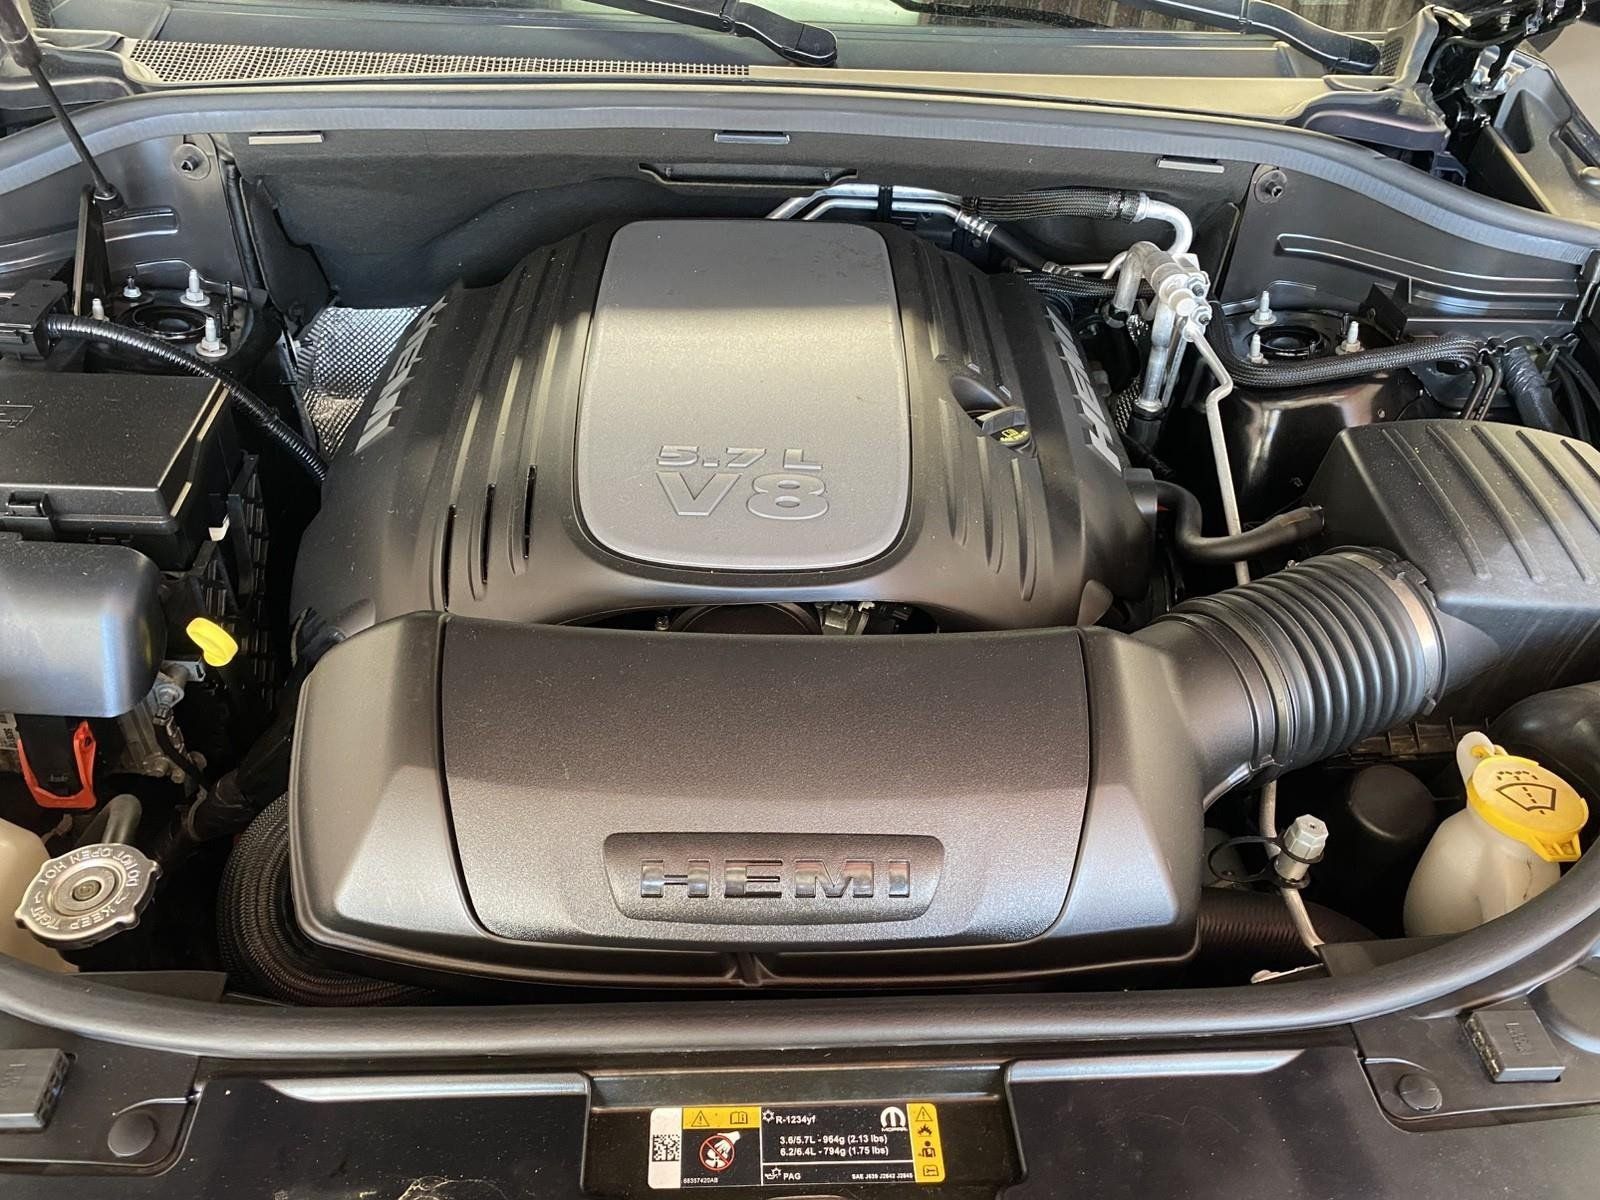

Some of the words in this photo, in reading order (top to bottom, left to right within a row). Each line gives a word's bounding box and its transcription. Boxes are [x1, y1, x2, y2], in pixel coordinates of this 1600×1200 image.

[353, 296, 449, 456] HEMI
[1045, 306, 1122, 474] HEMI
[656, 445, 767, 467] 5.7
[656, 471, 829, 520] V8
[70, 847, 113, 864] OPEN
[38, 861, 67, 886] HOT
[641, 859, 911, 898] HEMI
[70, 906, 116, 929] KEEP
[776, 1115, 816, 1125] R-1234yf
[780, 1136, 816, 1145] 3.6/5.7L
[823, 1135, 845, 1145] 964g
[848, 1135, 868, 1144] (2.13
[871, 1135, 888, 1144] lbs)
[780, 1147, 816, 1156] 6.2/6.4L
[824, 1147, 846, 1157] 794g
[849, 1146, 870, 1156] (1.75
[872, 1146, 889, 1155] lbs)
